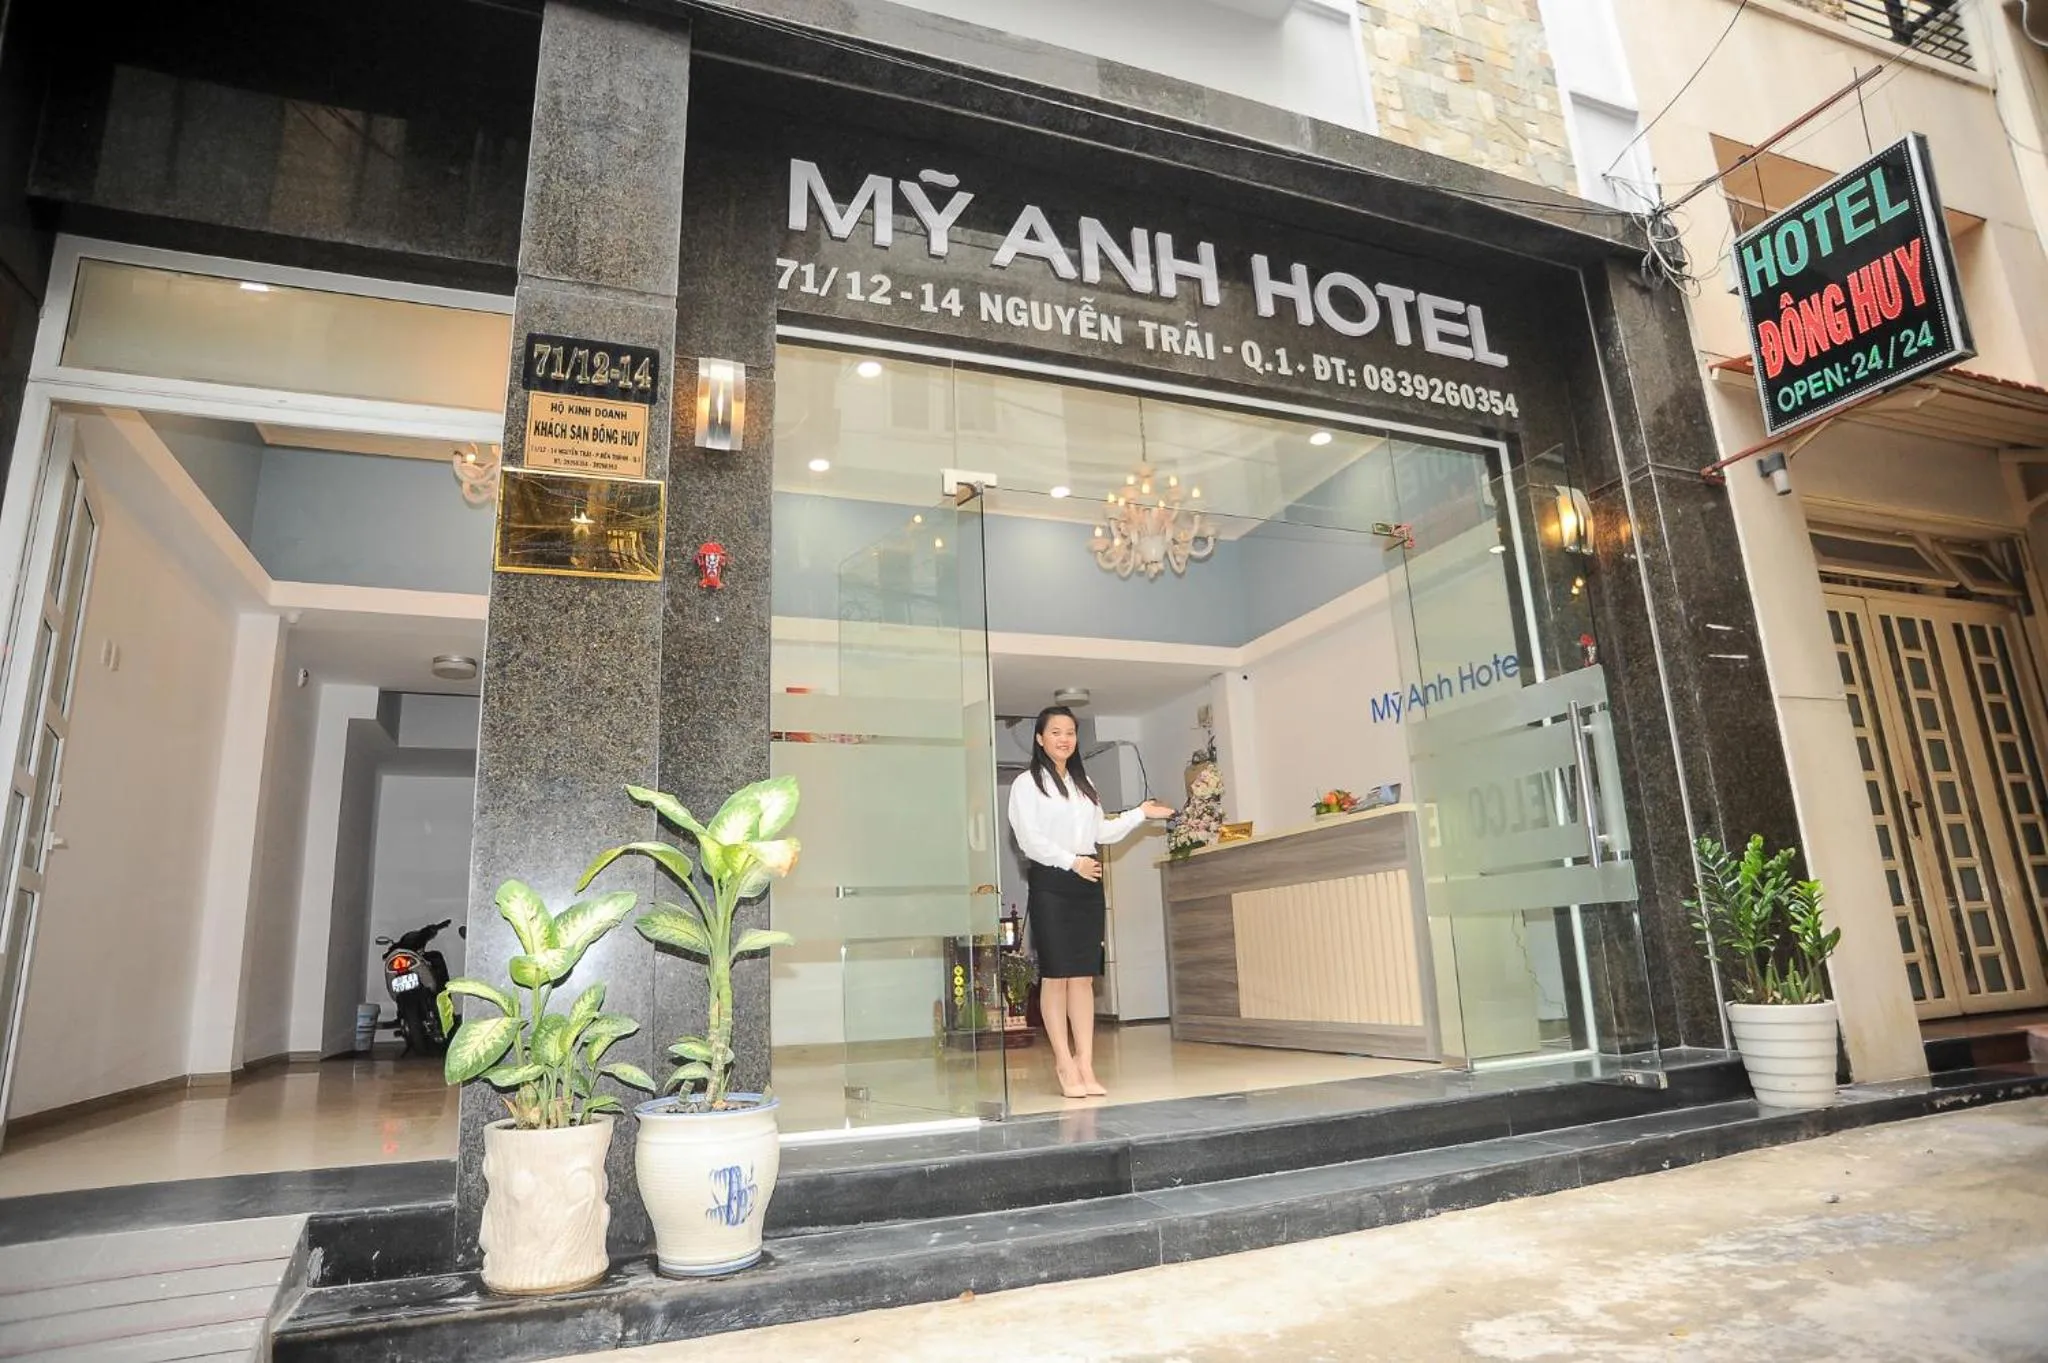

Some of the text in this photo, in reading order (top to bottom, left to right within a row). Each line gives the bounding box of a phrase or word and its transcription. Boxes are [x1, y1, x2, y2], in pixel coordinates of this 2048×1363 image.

[788, 157, 1509, 369] MỸ ANH HOTEL
[1741, 166, 1910, 298] HOTEL
[1758, 237, 1927, 379] ĐÔNG HUY
[533, 343, 653, 389] 71/12-14
[979, 296, 1123, 345] NGUYỄN
[1138, 320, 1215, 360] TRÃI
[1312, 353, 1357, 387] ĐT:
[1363, 364, 1519, 418] 0839260354
[533, 417, 568, 440] KHÁCH
[569, 423, 590, 444] SẠN
[620, 430, 641, 447] HUY
[550, 401, 628, 420] HỘ KINH DOANH
[1370, 690, 1404, 724] Mỹ
[1406, 673, 1453, 712] Anh
